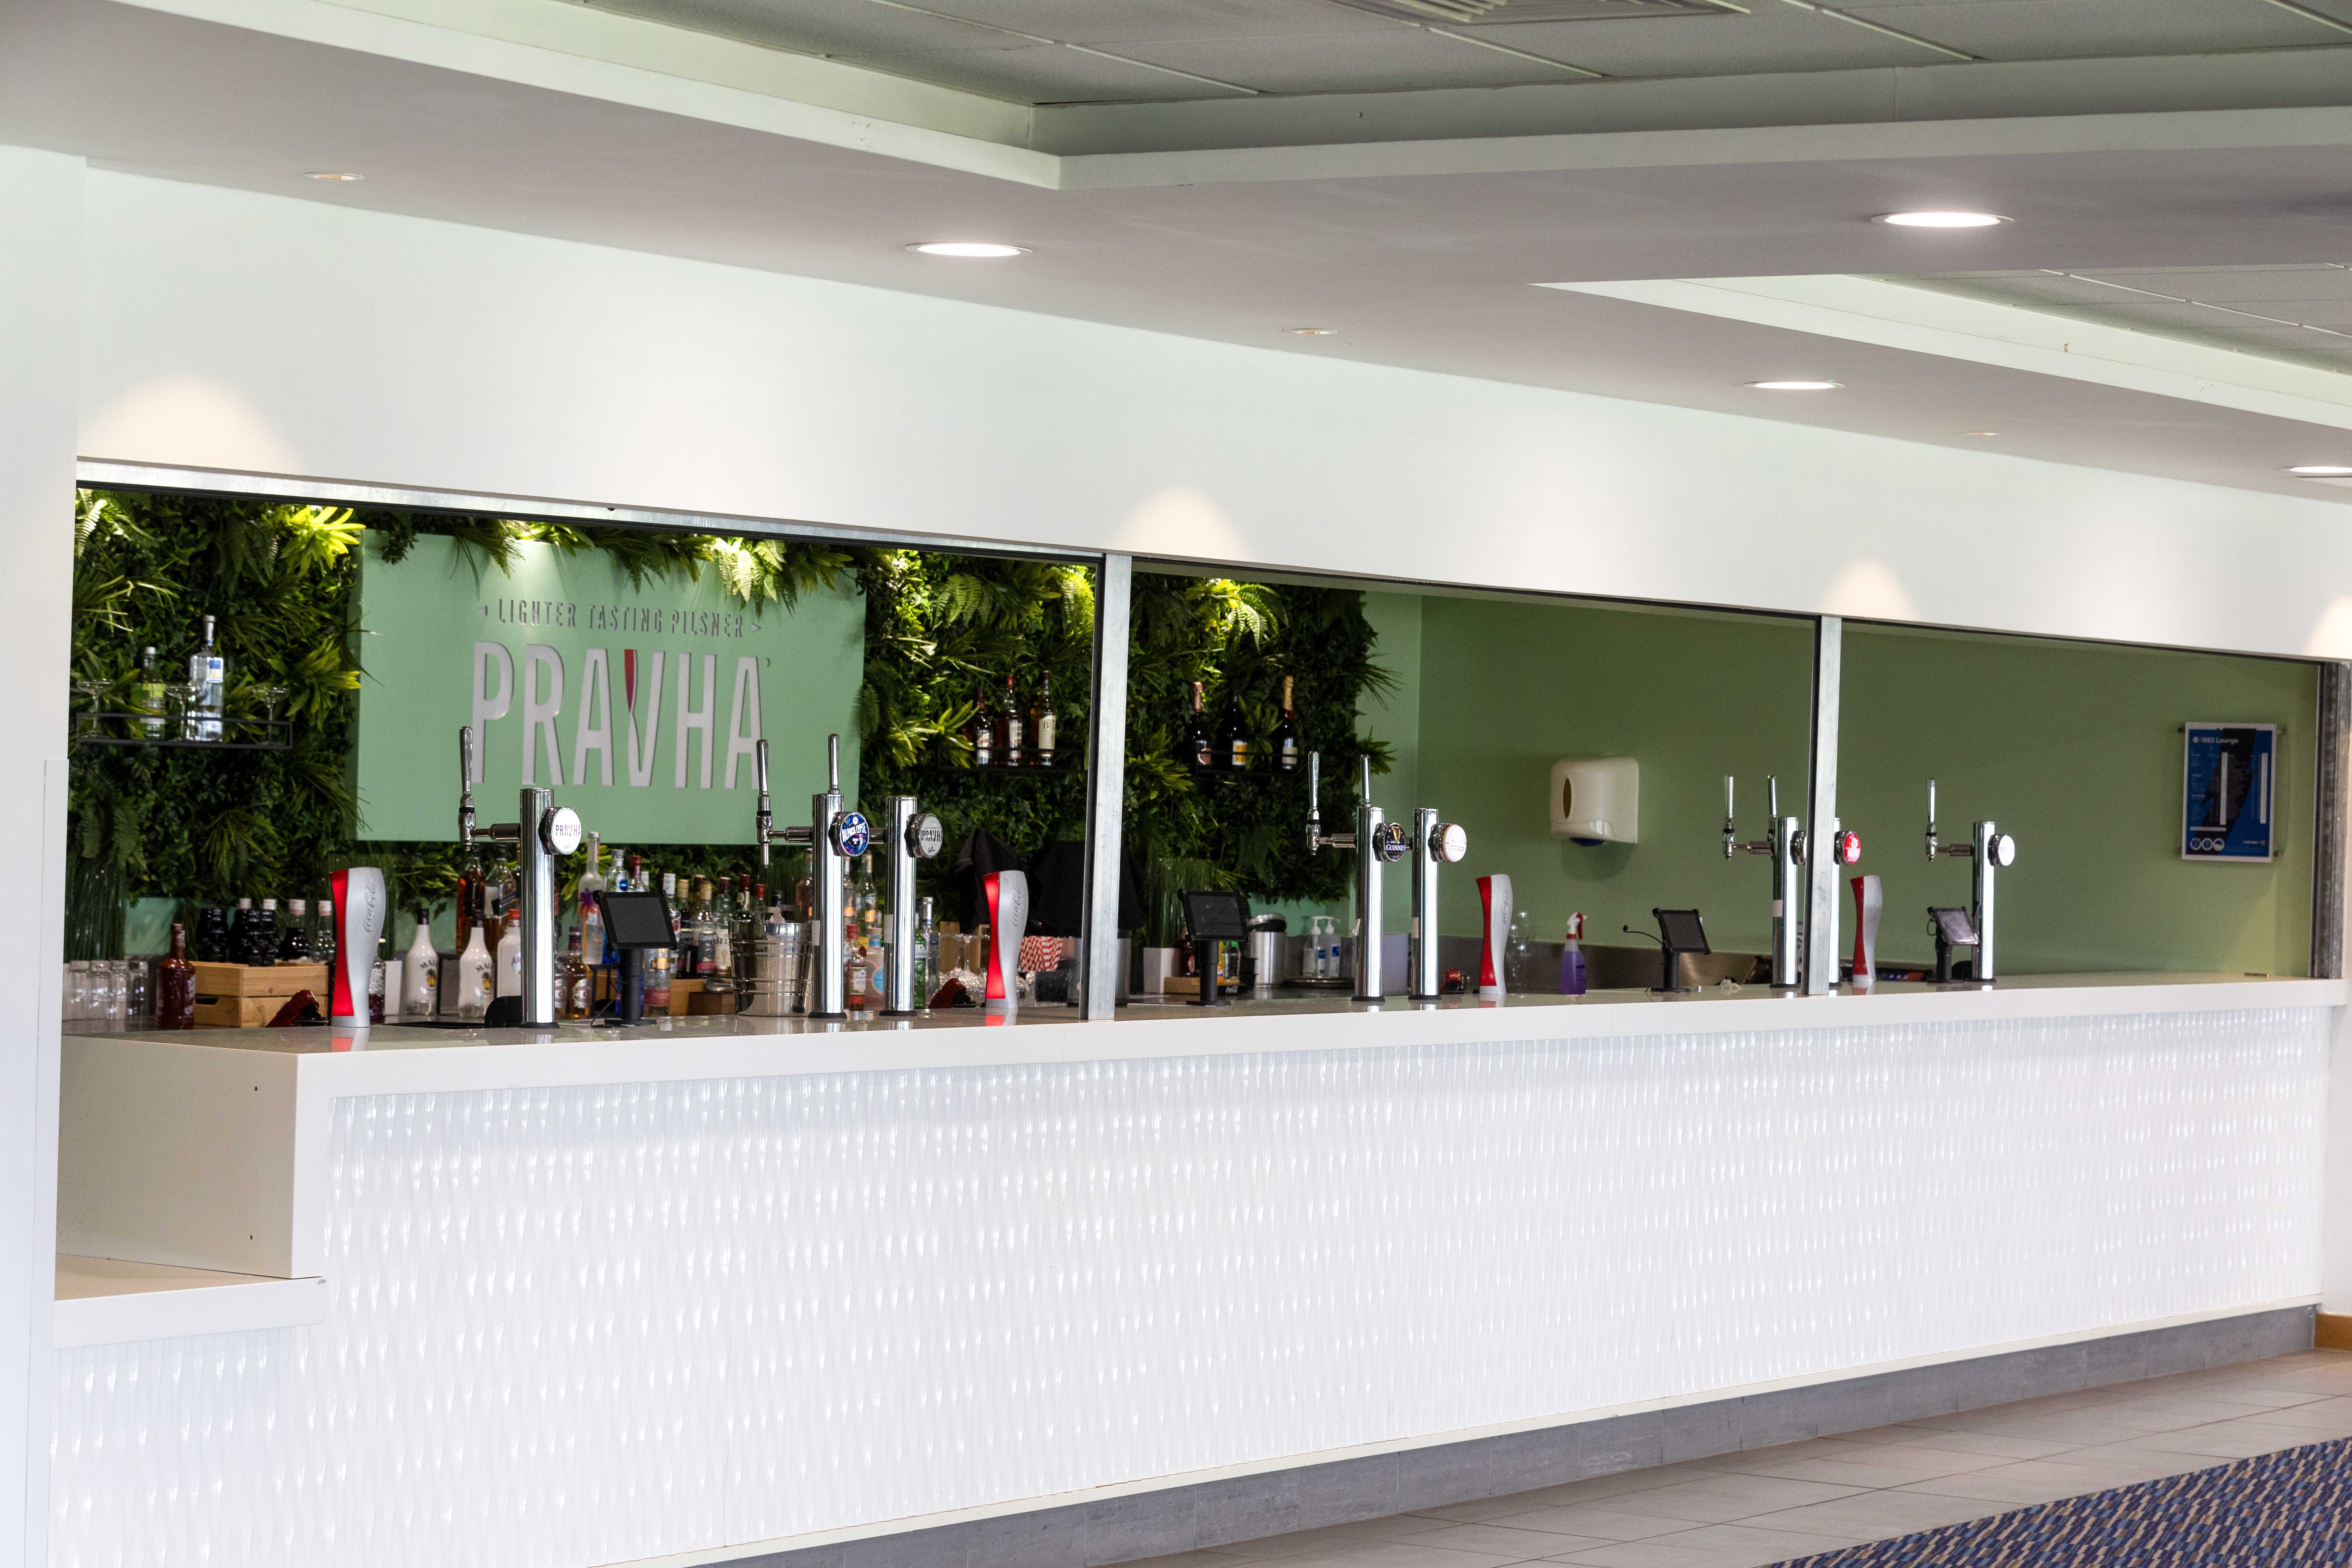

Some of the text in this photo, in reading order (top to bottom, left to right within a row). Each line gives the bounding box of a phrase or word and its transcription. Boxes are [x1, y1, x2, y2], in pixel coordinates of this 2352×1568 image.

[499, 599, 743, 638] LIGHTER TASTING PILSNER
[471, 641, 763, 789] PRAVHA
[556, 825, 581, 837] PRAVHA
[362, 882, 376, 932] Coca-Cola
[1011, 884, 1021, 927] Coca-Cola
